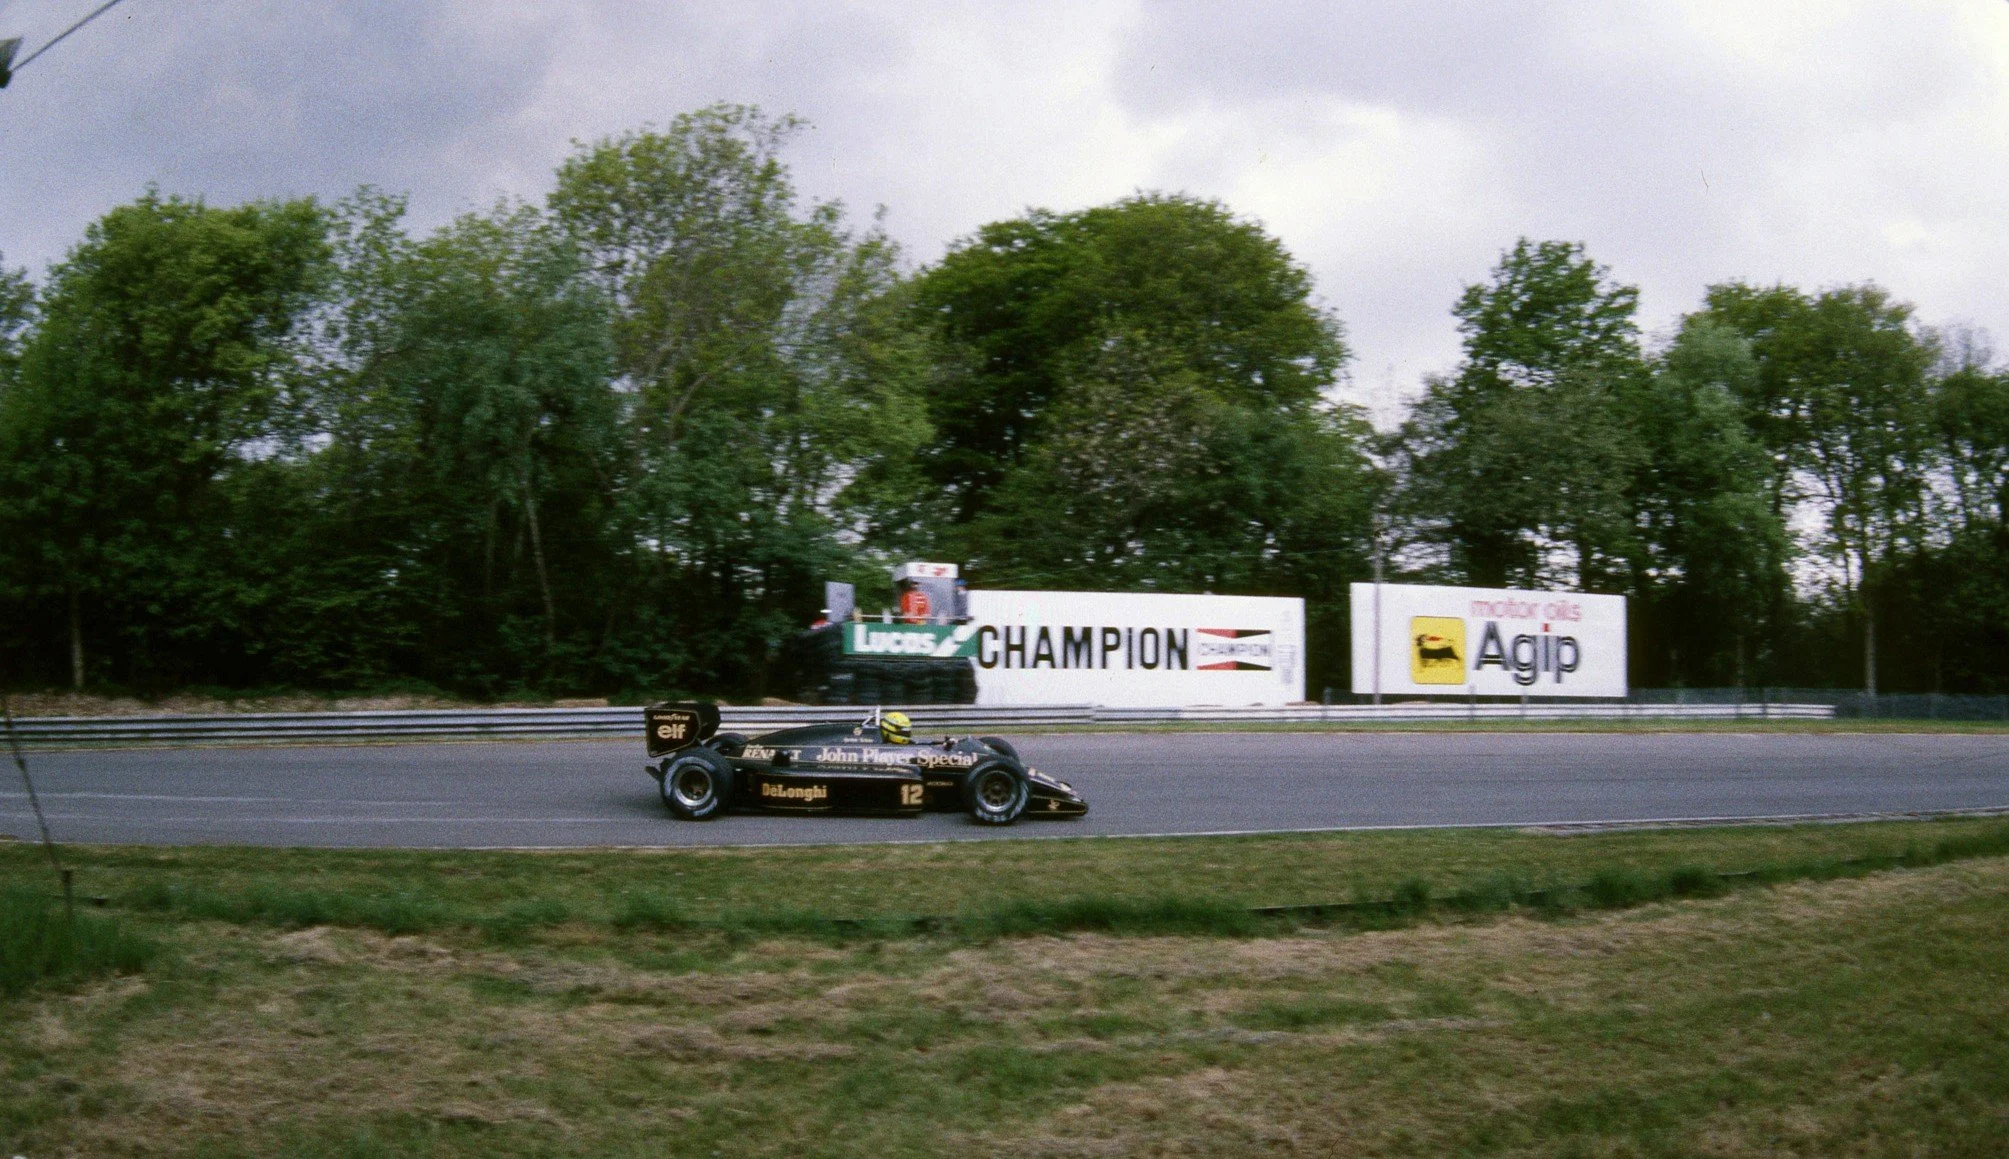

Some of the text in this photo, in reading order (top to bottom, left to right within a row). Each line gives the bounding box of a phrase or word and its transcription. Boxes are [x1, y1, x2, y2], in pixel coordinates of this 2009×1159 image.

[1471, 599, 1582, 621] motor oils
[977, 625, 1188, 669] CHAMPION
[1198, 642, 1271, 657] CHAMPION
[1474, 621, 1581, 686] Agip
[657, 723, 687, 739] elf
[816, 747, 859, 763] John
[862, 748, 912, 766] Player
[901, 783, 924, 806] 12
